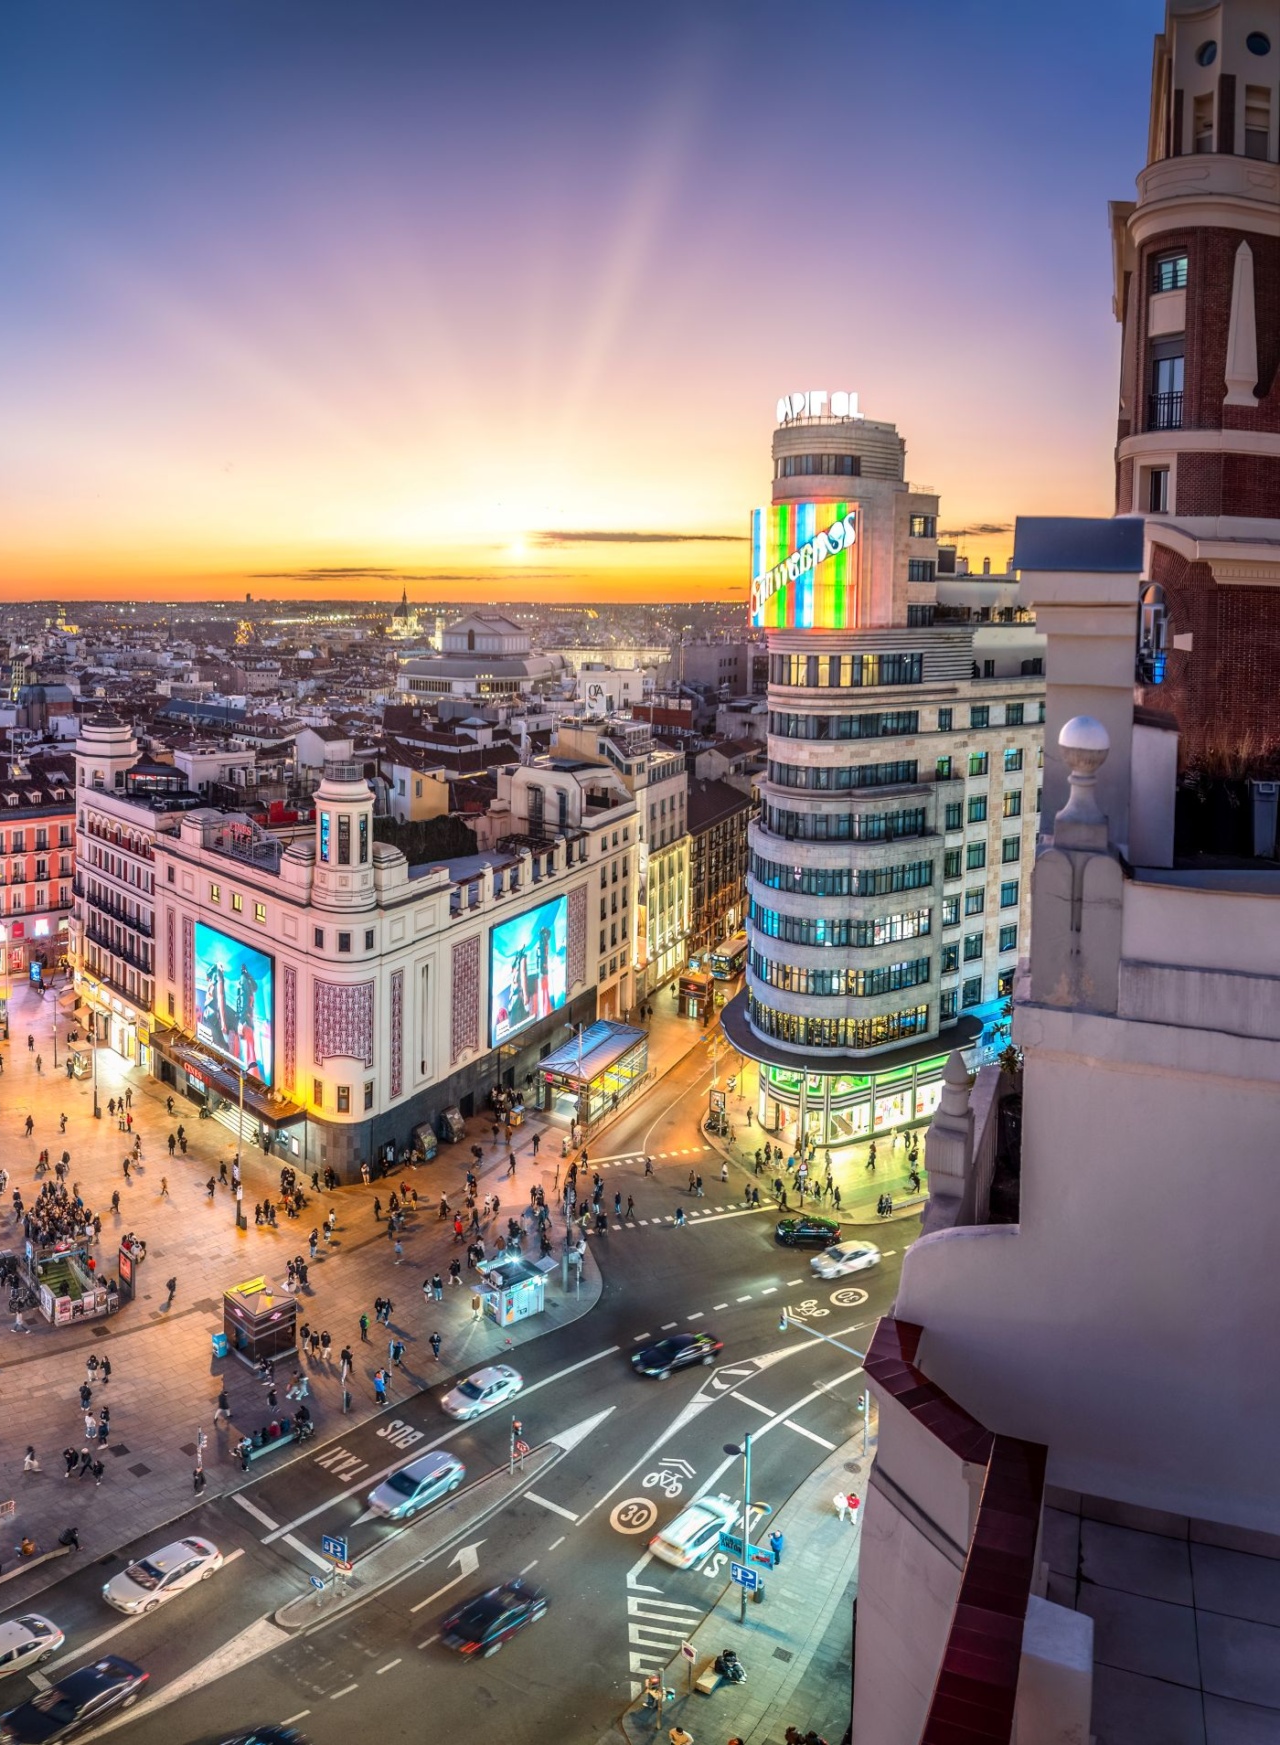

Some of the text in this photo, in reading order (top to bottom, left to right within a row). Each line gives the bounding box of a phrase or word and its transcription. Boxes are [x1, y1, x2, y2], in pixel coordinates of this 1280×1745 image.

[376, 1419, 425, 1450] BUS
[313, 1446, 370, 1482] TAXI
[620, 1504, 649, 1526] 30
[736, 1566, 755, 1582] P
